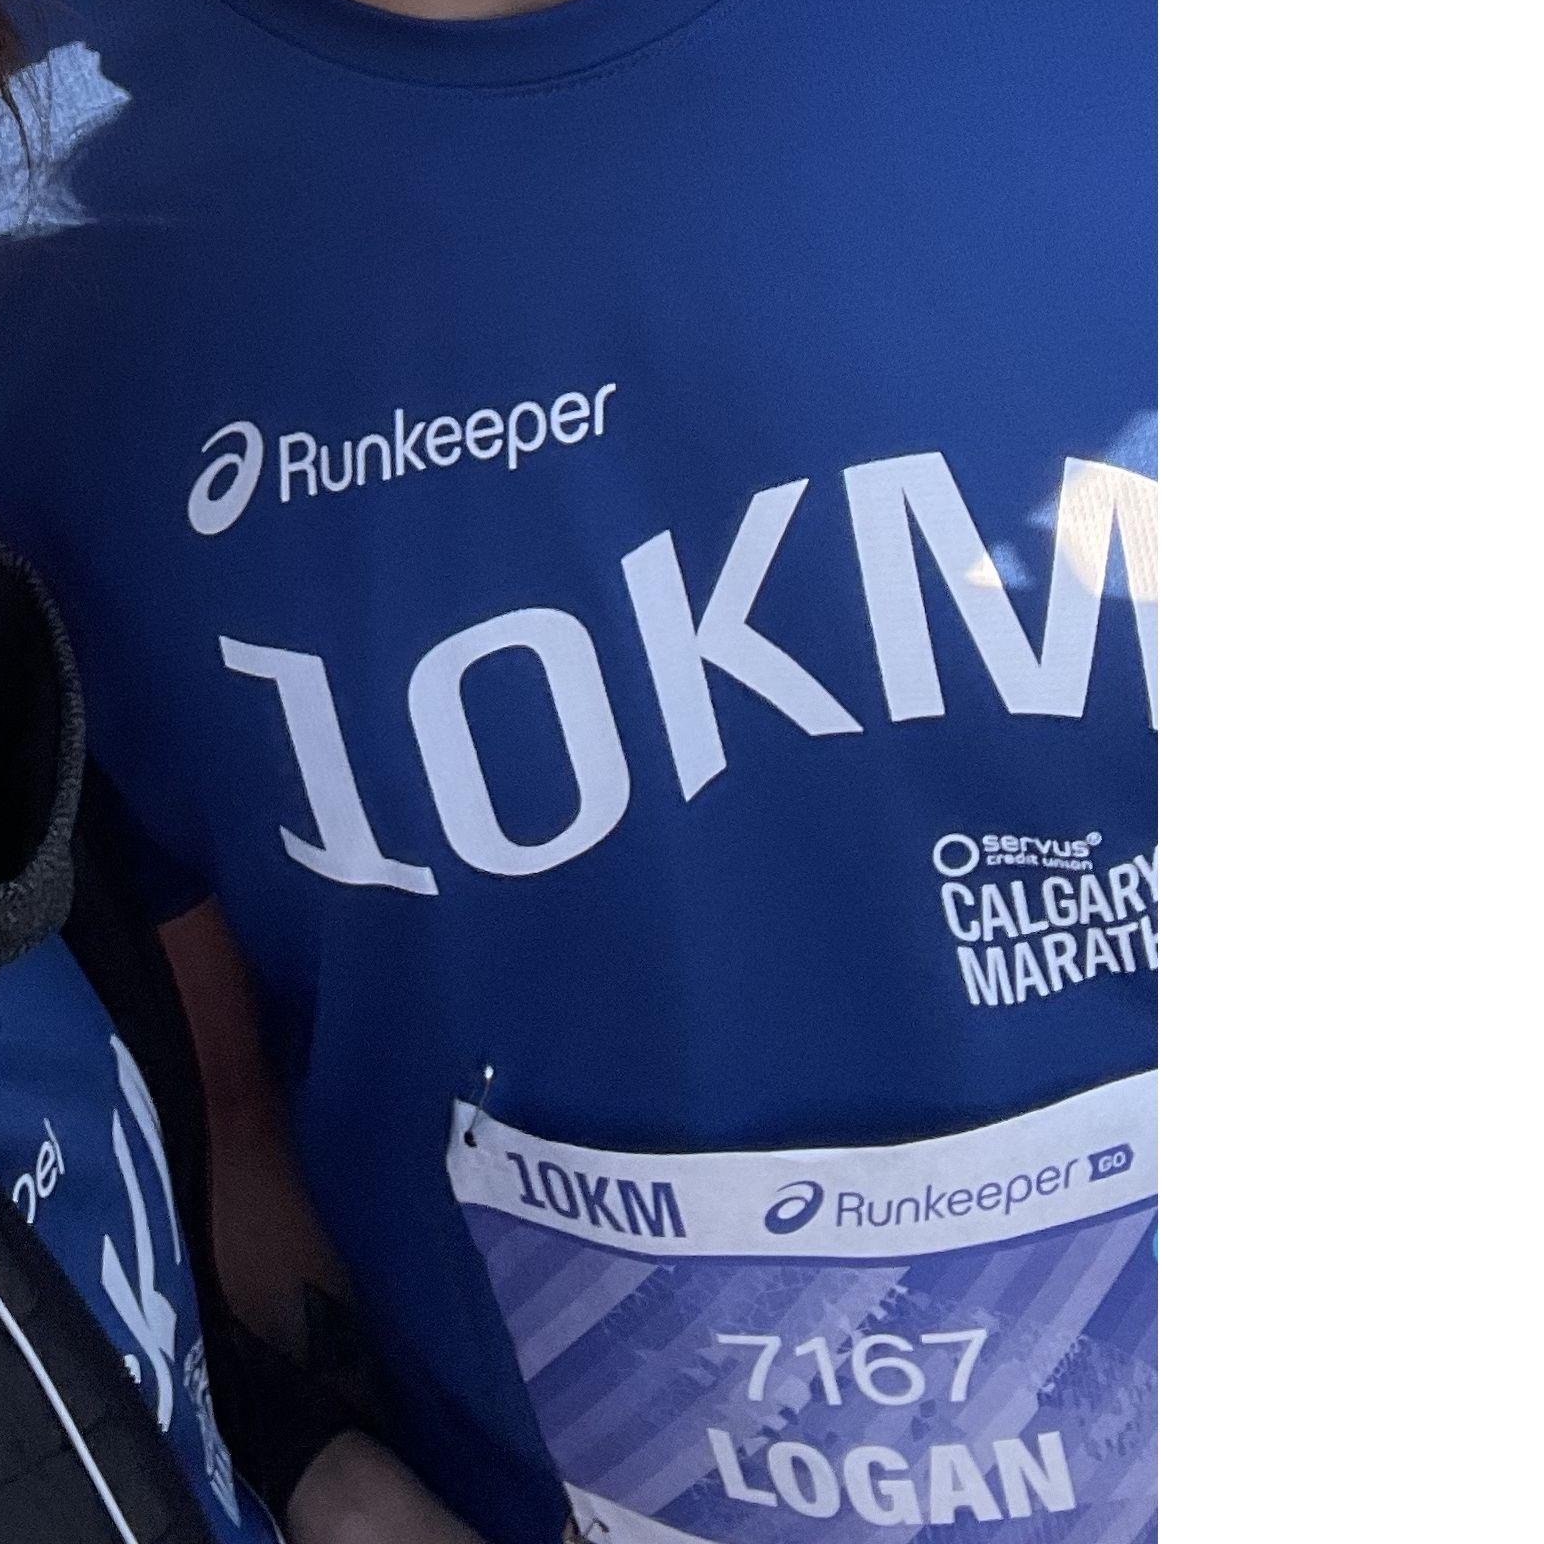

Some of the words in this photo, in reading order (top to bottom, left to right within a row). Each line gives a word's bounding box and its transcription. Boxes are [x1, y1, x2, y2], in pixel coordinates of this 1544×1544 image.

[279, 382, 618, 504] Runkeeper
[218, 451, 1158, 896] 10KM
[505, 1150, 687, 1239] 10KM
[834, 1157, 1080, 1229] Runkeeper
[715, 1328, 989, 1407] 7167
[707, 1428, 1078, 1527] LOGAN
